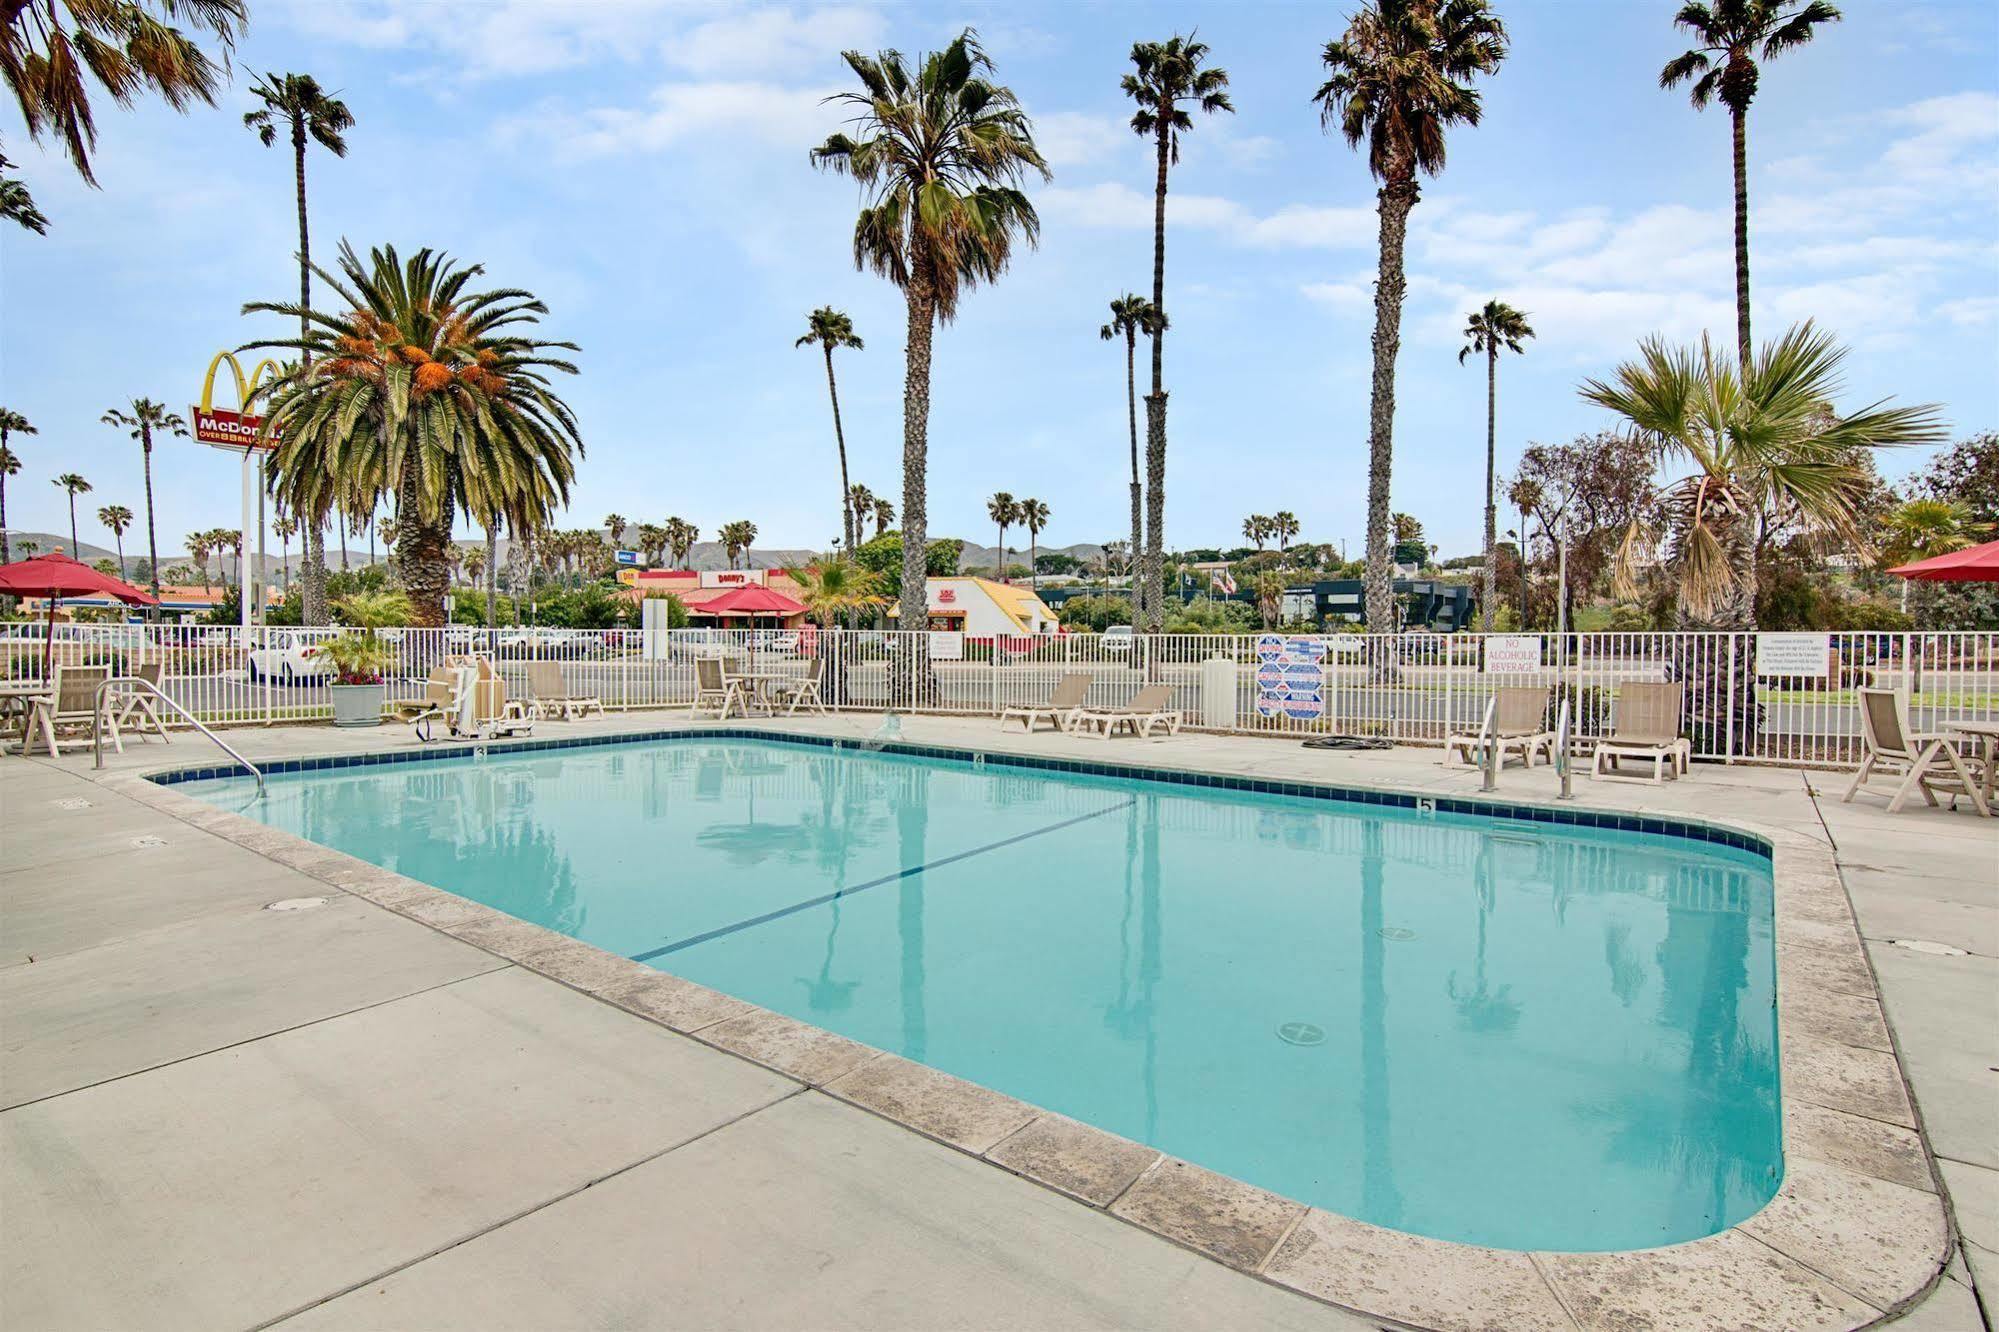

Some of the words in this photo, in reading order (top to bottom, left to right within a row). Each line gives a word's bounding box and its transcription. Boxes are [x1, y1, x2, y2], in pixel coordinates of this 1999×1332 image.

[718, 574, 745, 583] Denny's
[1505, 639, 1519, 648] NO
[1259, 644, 1283, 653] DIVING
[1488, 650, 1537, 661] ALCOHOLIC
[1491, 662, 1535, 672] BEVERAGE
[1420, 798, 1432, 812] 5
